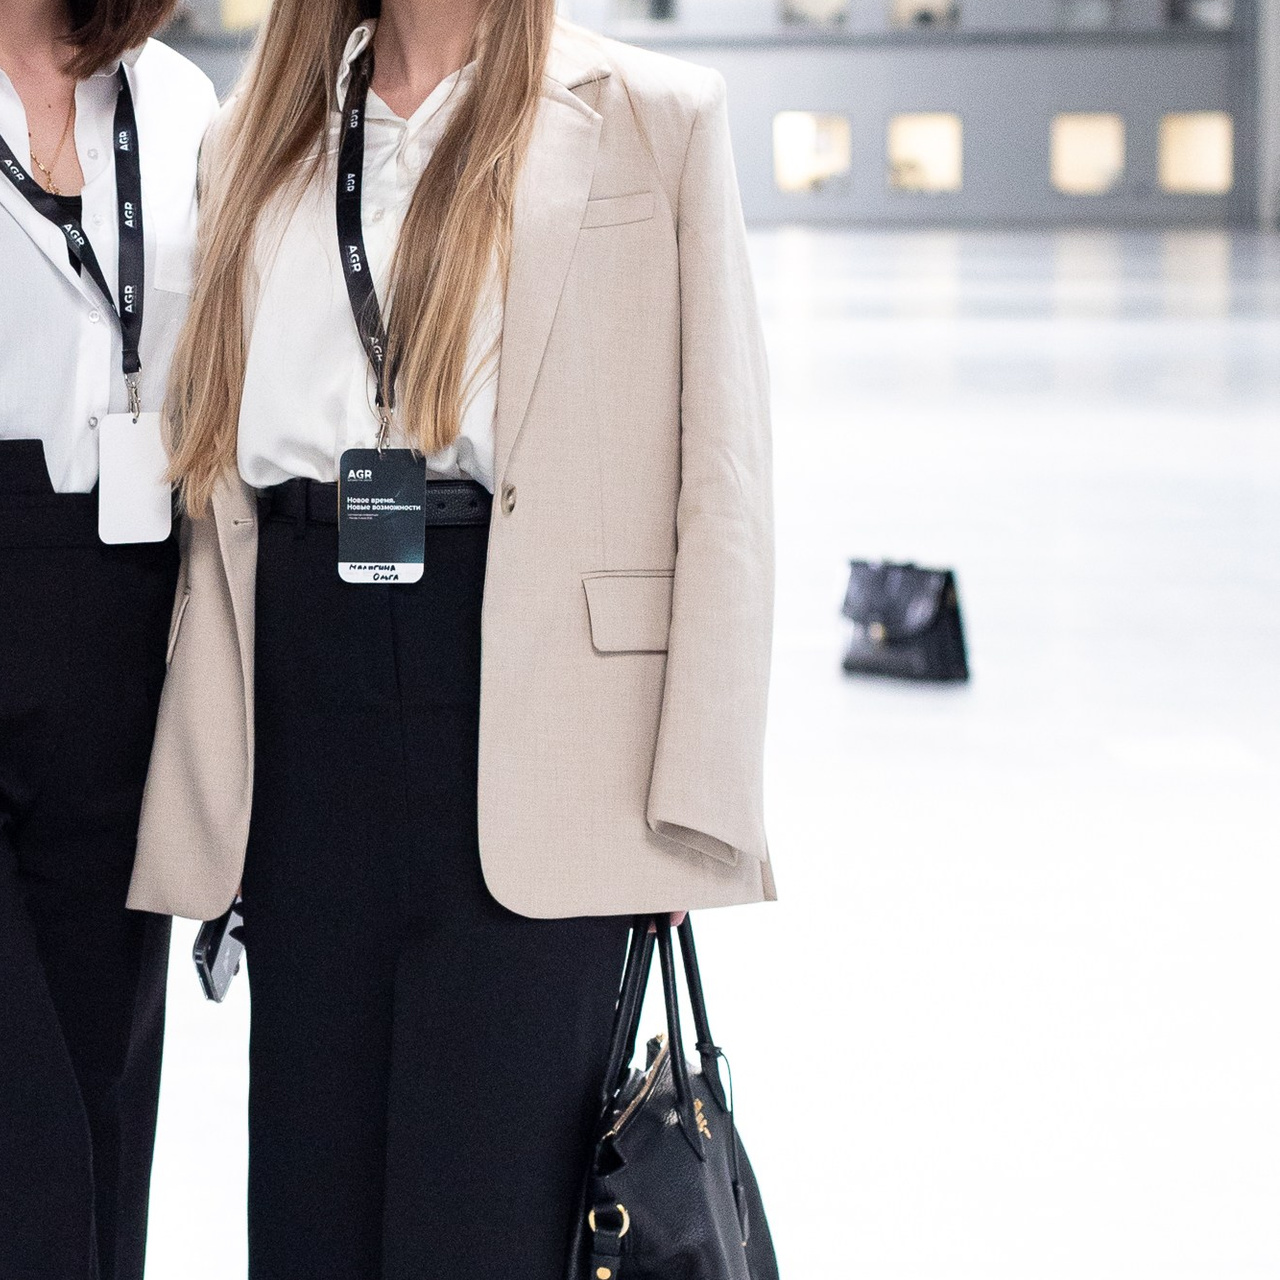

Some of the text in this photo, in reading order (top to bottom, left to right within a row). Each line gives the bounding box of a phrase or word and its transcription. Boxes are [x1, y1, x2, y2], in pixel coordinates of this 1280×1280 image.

[119, 130, 129, 151] AGR
[4, 159, 25, 181] AGR
[124, 202, 134, 228] AGR
[64, 224, 85, 247] AGR
[348, 245, 362, 272] AGR
[124, 285, 134, 313] AGR
[347, 469, 372, 479] AGR
